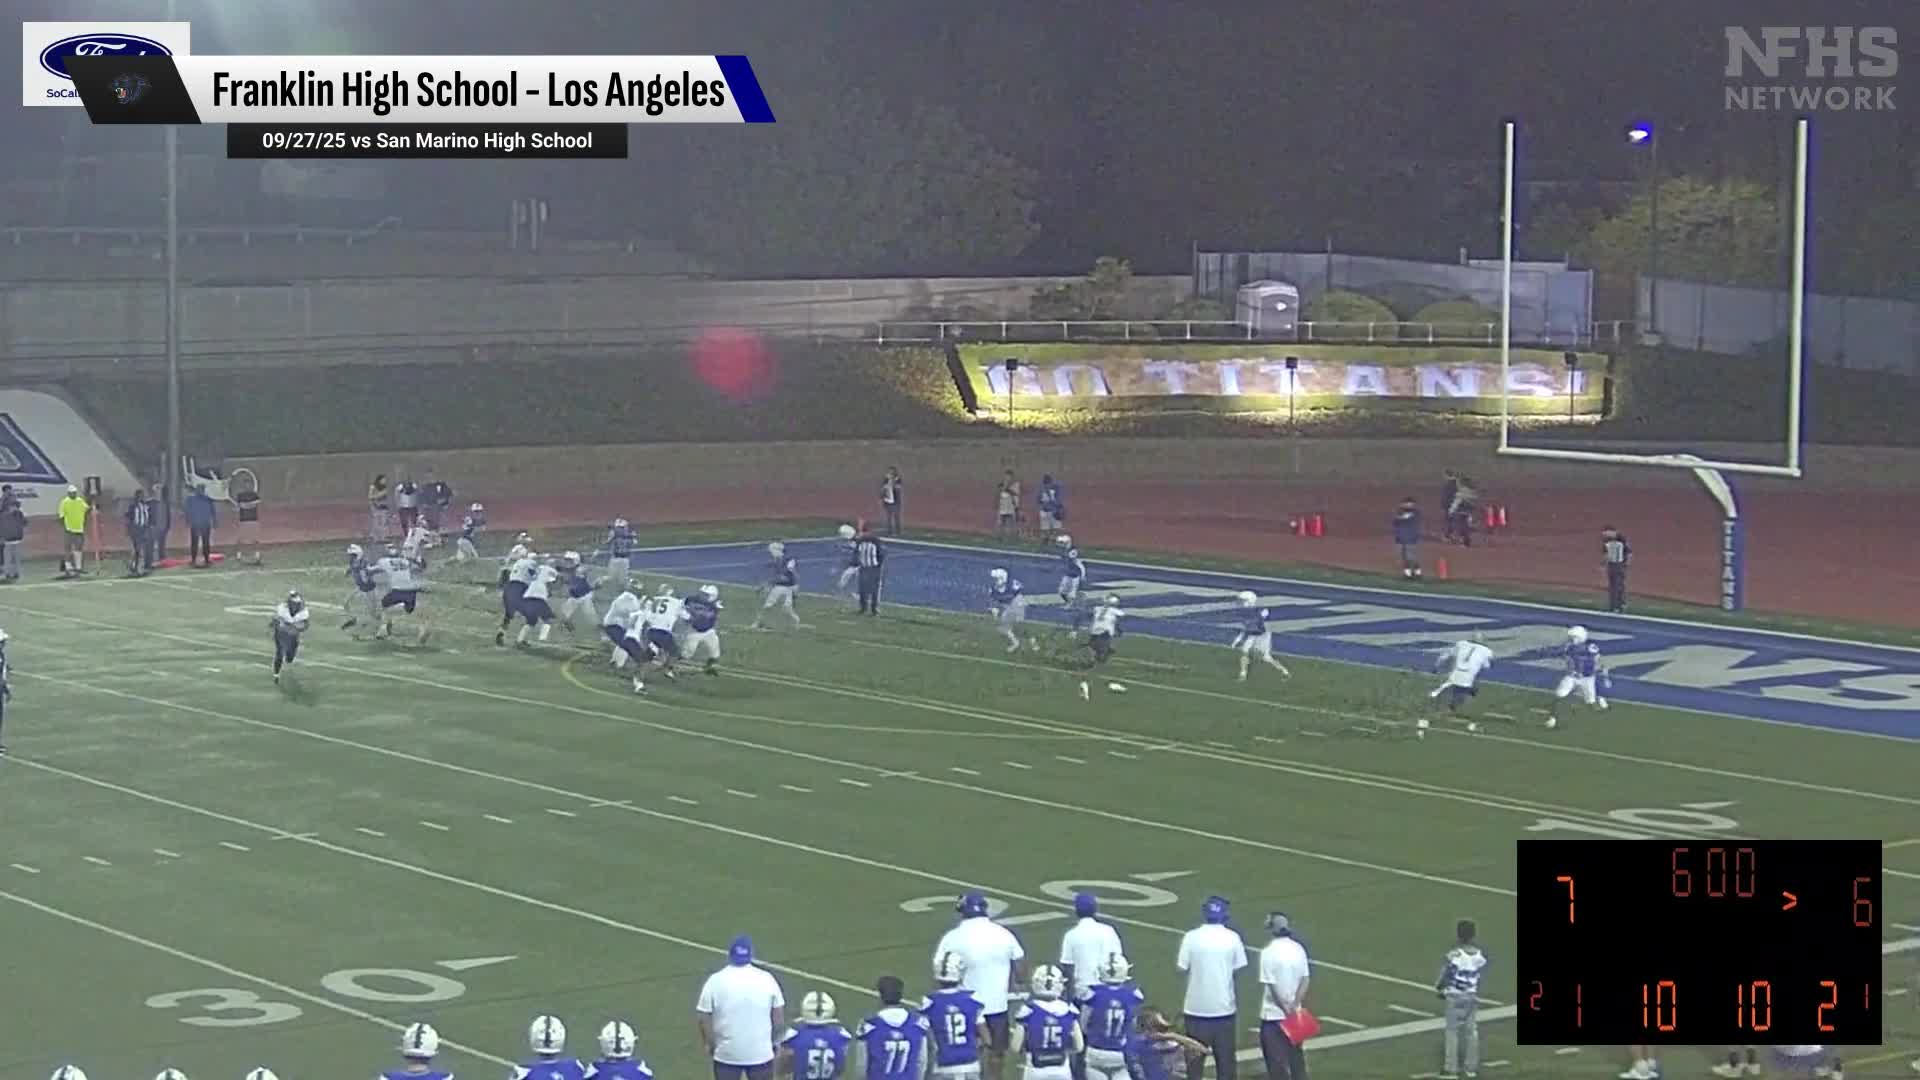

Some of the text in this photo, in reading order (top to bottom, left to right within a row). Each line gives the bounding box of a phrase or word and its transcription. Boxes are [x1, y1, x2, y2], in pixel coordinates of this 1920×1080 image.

[1722, 520, 1736, 611] TITANS
[944, 1012, 967, 1045] 12
[1042, 1026, 1063, 1049] 15
[1106, 1009, 1126, 1037] 17
[806, 1048, 836, 1079] 56
[883, 1040, 911, 1074] 77
